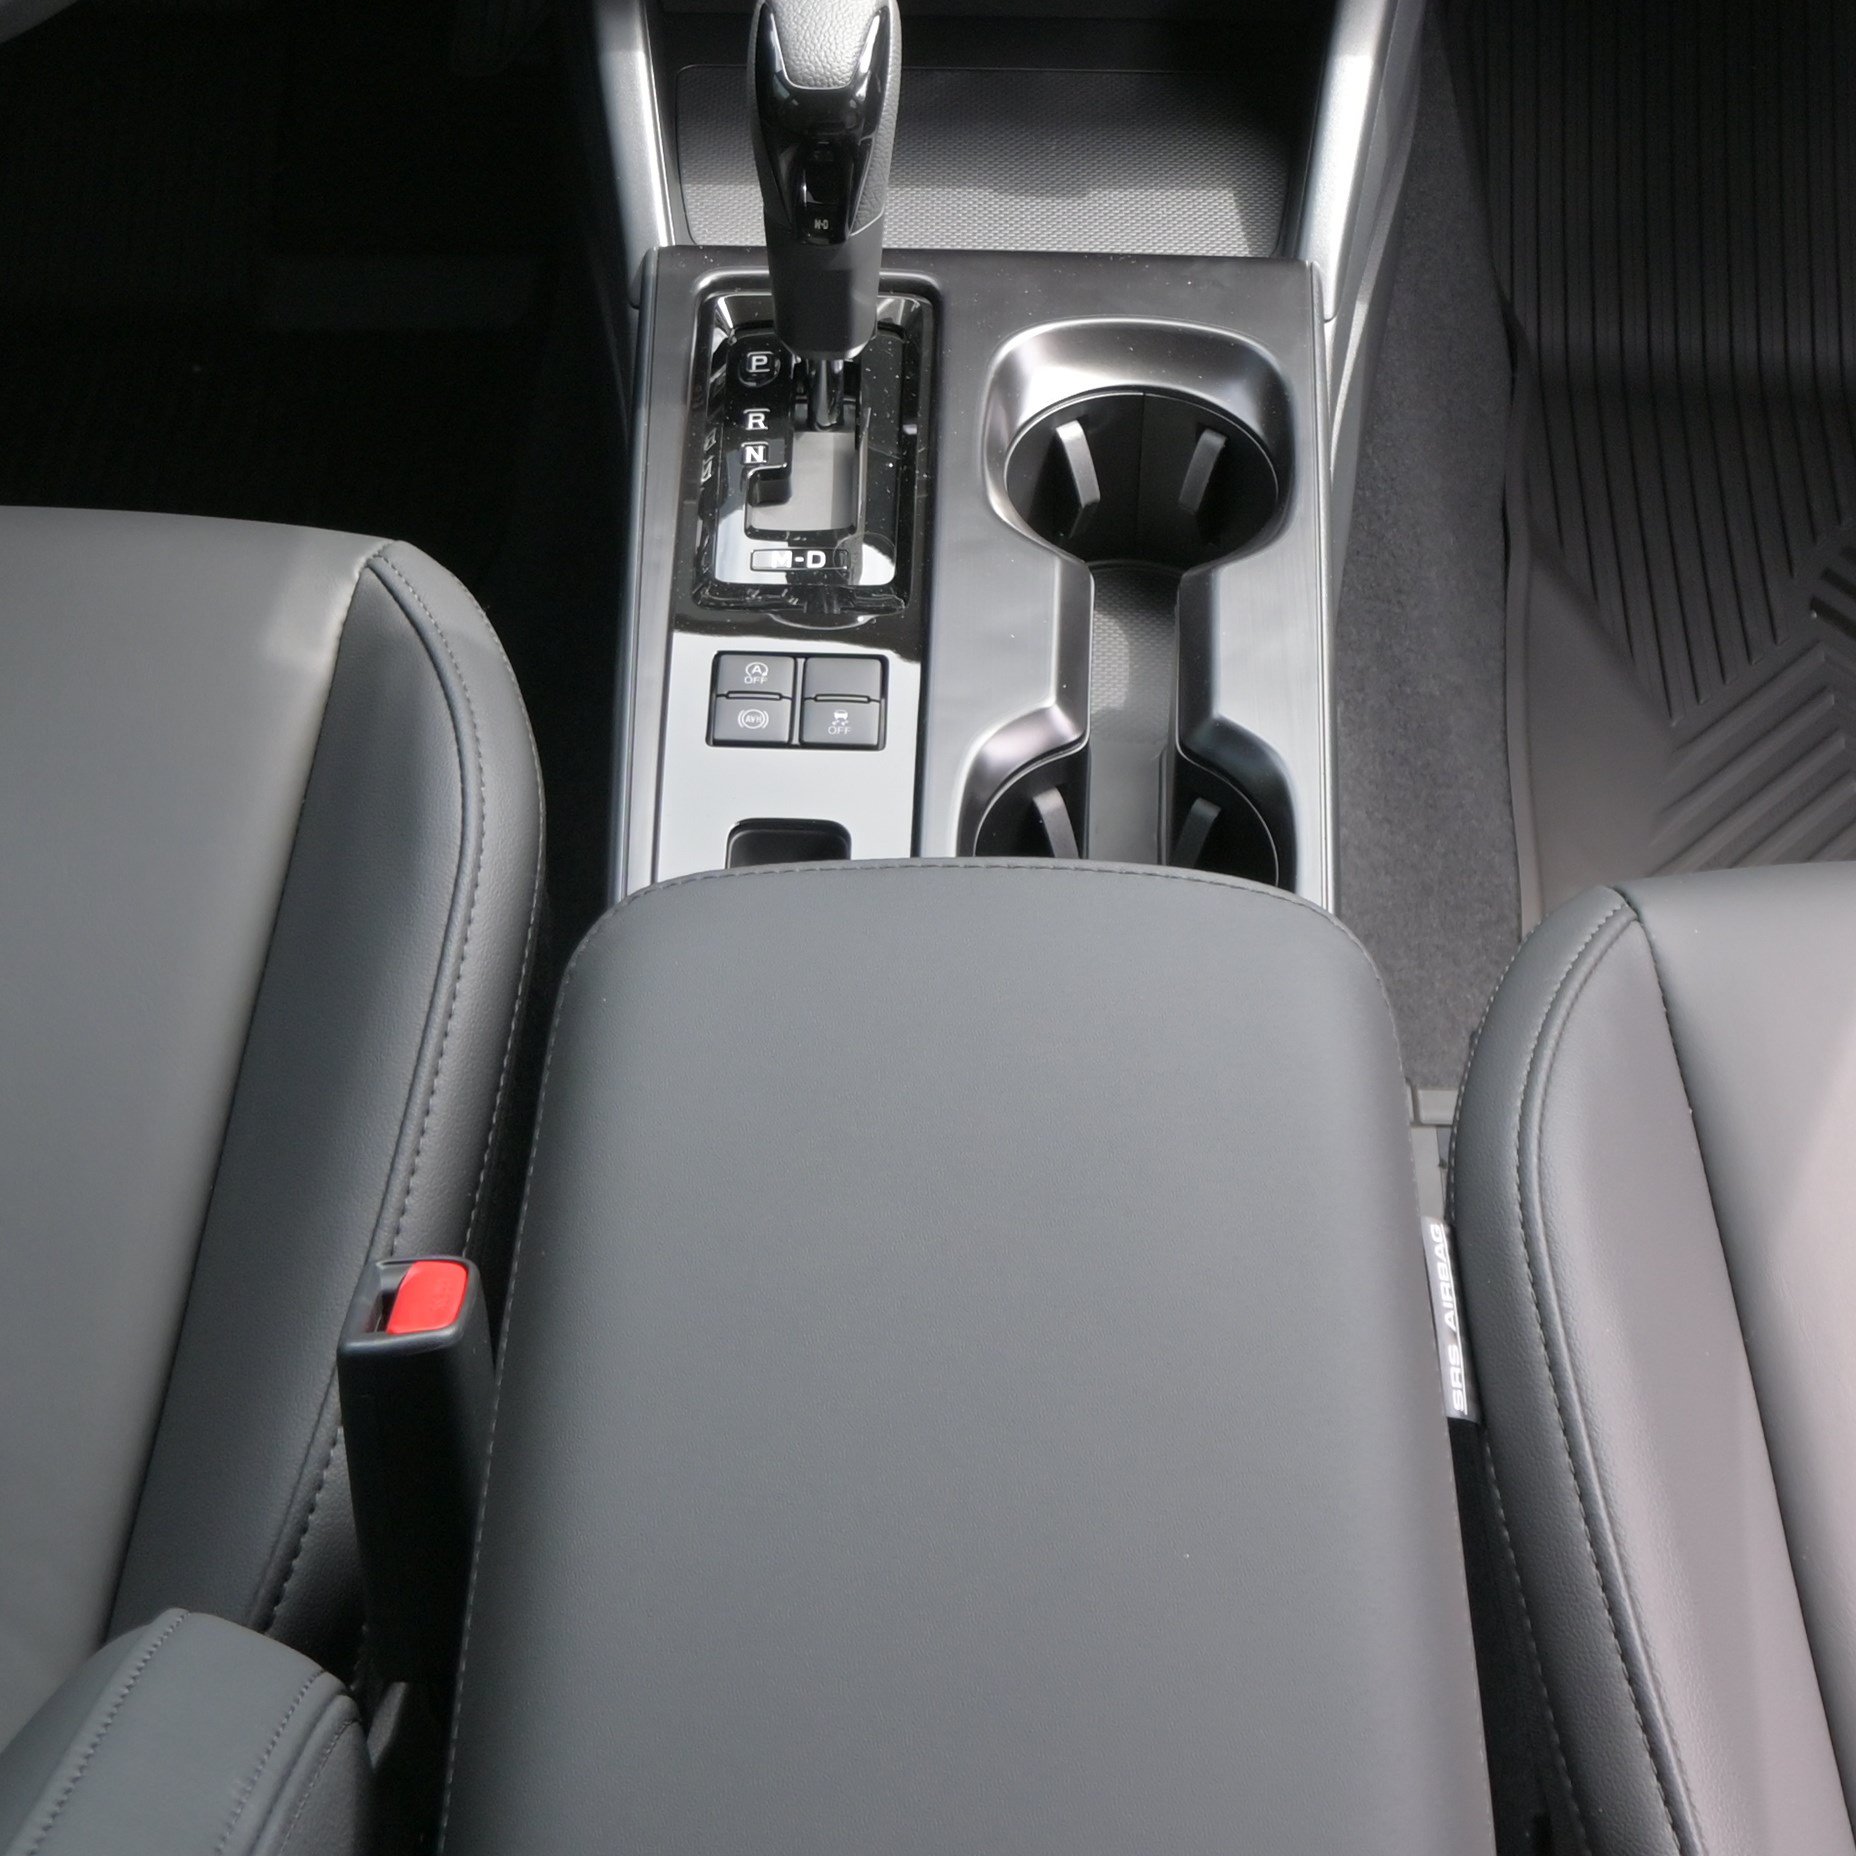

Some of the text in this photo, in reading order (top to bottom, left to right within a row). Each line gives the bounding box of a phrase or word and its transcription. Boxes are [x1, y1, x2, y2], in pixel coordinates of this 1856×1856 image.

[751, 356, 769, 372] P
[747, 413, 768, 430] R
[745, 445, 766, 463] N
[771, 550, 827, 569] M-D
[744, 677, 769, 685] OFF
[828, 726, 853, 735] OFF
[1430, 1223, 1466, 1413] SRS AIRBAG
